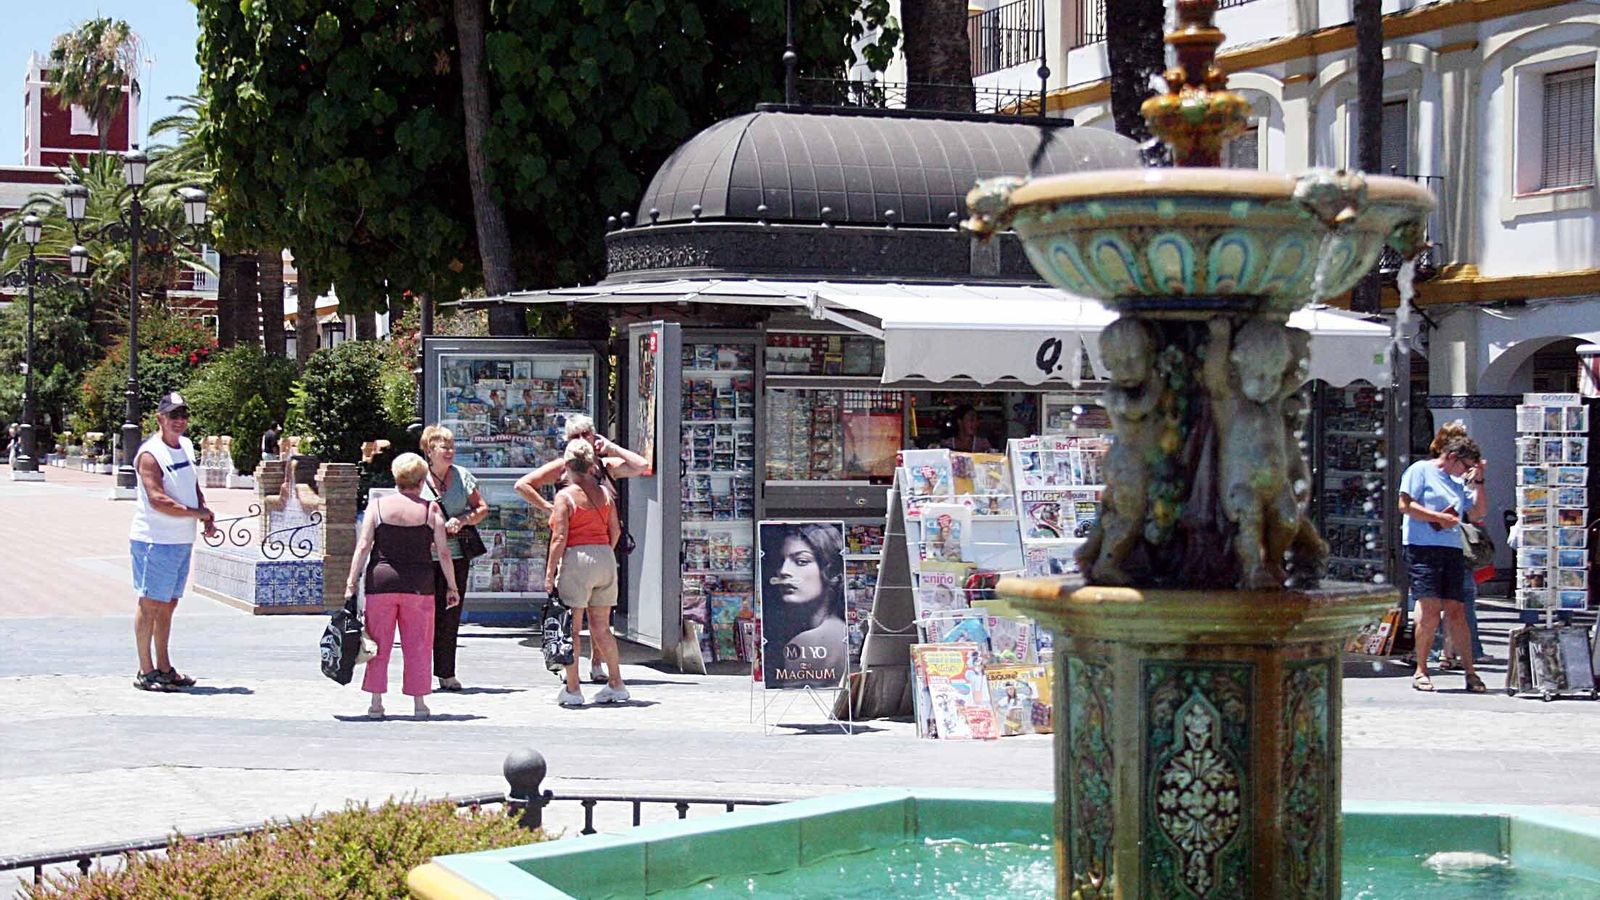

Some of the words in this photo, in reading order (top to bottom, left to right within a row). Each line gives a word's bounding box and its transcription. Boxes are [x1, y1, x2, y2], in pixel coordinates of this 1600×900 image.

[1023, 491, 1059, 501] Biker
[930, 572, 954, 584] niño
[775, 668, 836, 680] MAGNUM
